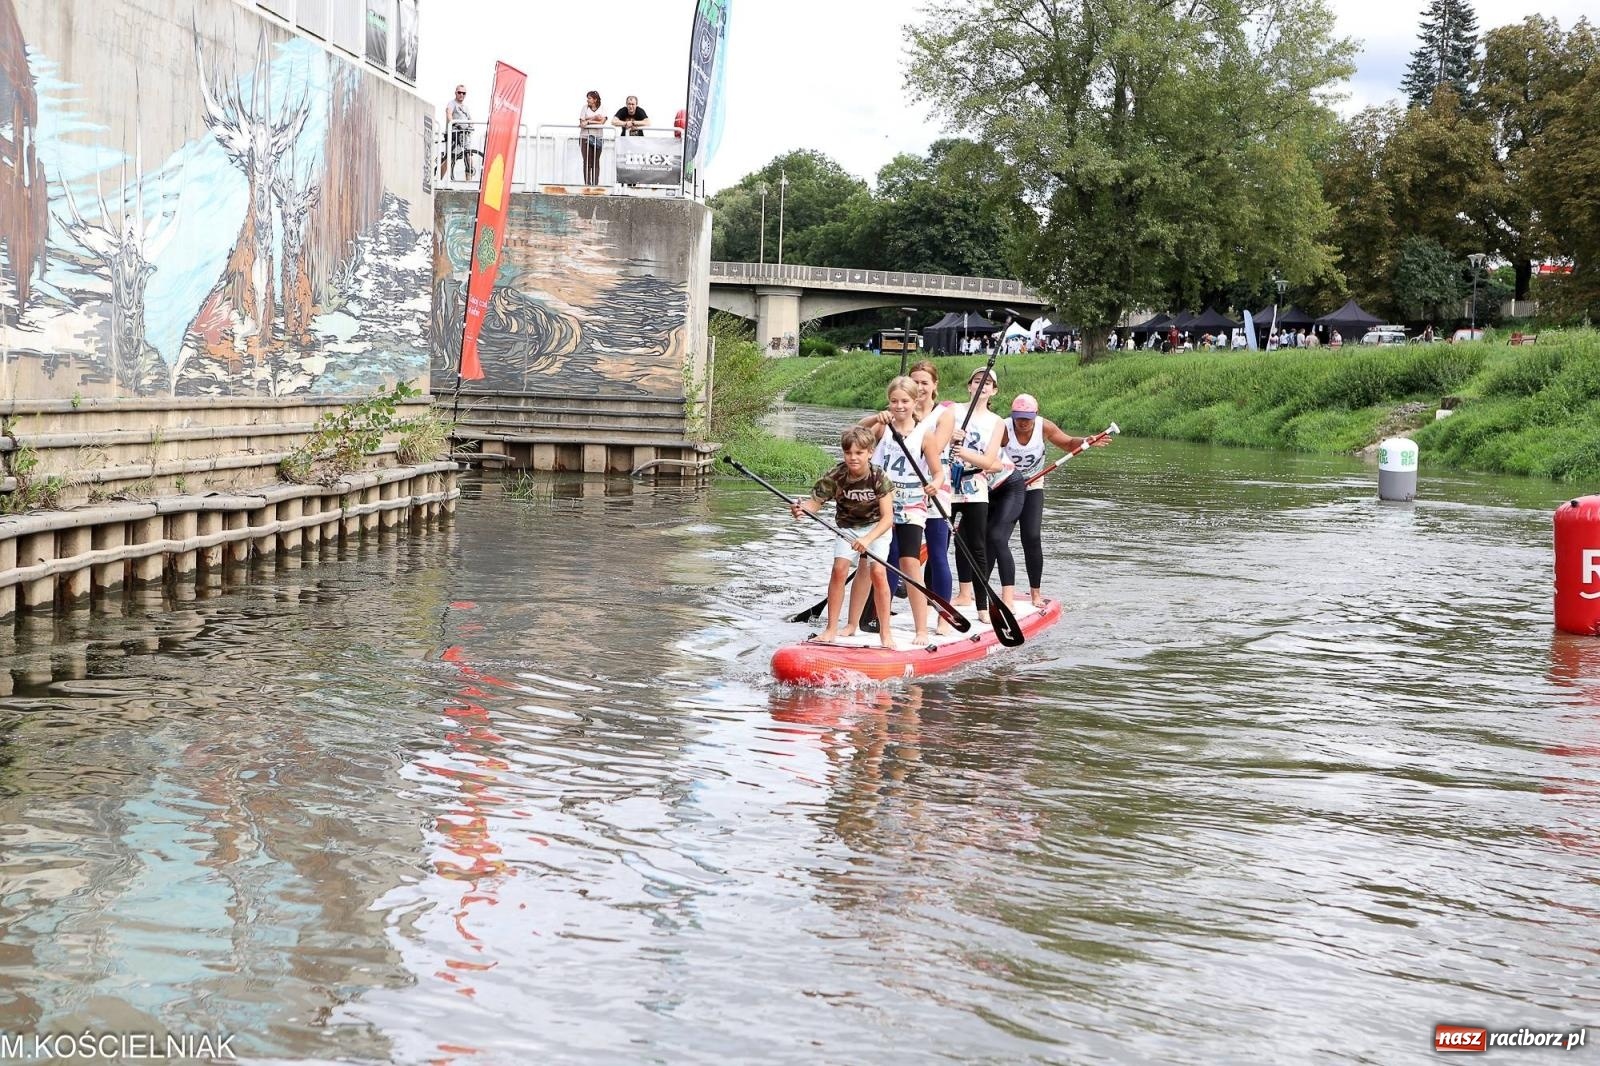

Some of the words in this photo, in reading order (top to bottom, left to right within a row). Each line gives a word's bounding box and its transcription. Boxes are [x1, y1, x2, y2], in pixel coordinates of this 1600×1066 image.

[883, 454, 907, 477] 14
[1011, 454, 1036, 468] 23
[842, 489, 877, 502] VANS
